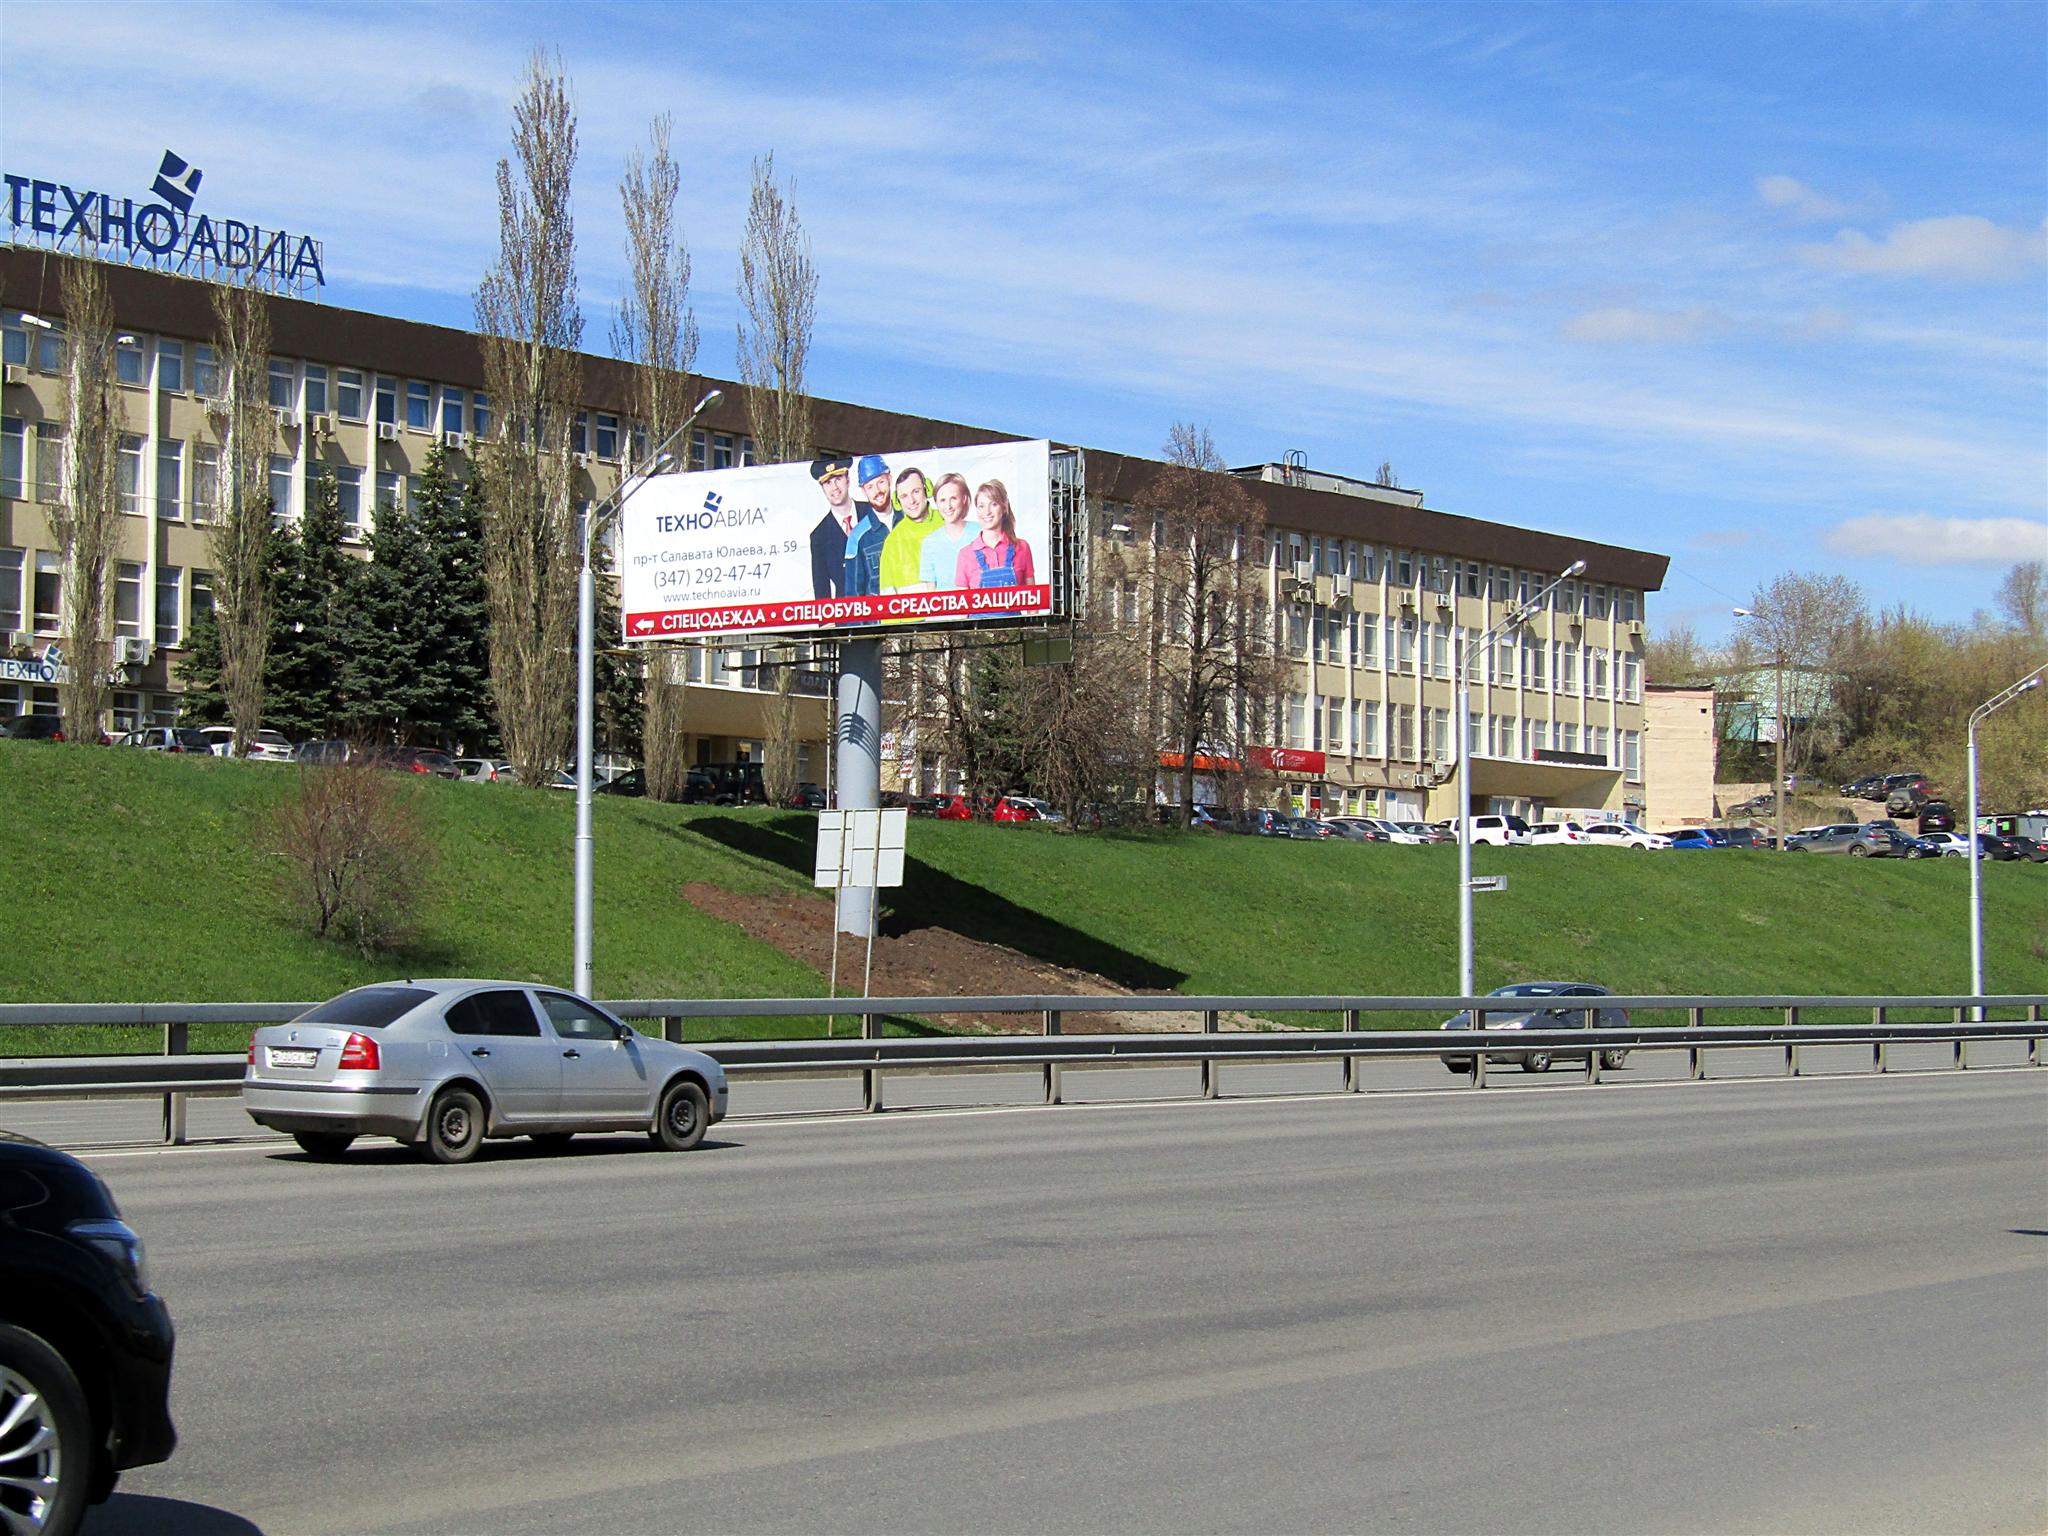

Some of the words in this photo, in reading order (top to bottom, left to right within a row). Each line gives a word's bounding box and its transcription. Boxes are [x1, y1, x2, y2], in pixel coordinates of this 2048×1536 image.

[4, 174, 325, 286] ТЕХНОАВИА
[656, 508, 765, 532] ТЕХНОАВИА
[633, 554, 658, 567] пр-т
[661, 549, 713, 563] Салавата
[716, 545, 767, 558] Юлаева,
[769, 544, 780, 555] д.
[783, 540, 797, 553] 59
[654, 568, 690, 589] (347)
[695, 563, 771, 584] 292-47-47
[663, 587, 761, 602] www.technoavia.ru
[661, 609, 765, 630] СПЕЦОДЕЖДА
[782, 602, 871, 622] СПЕЦОБУВЬ
[888, 594, 968, 614] СРЕДСТВА
[972, 590, 1041, 609] ЗАЩИТЫ
